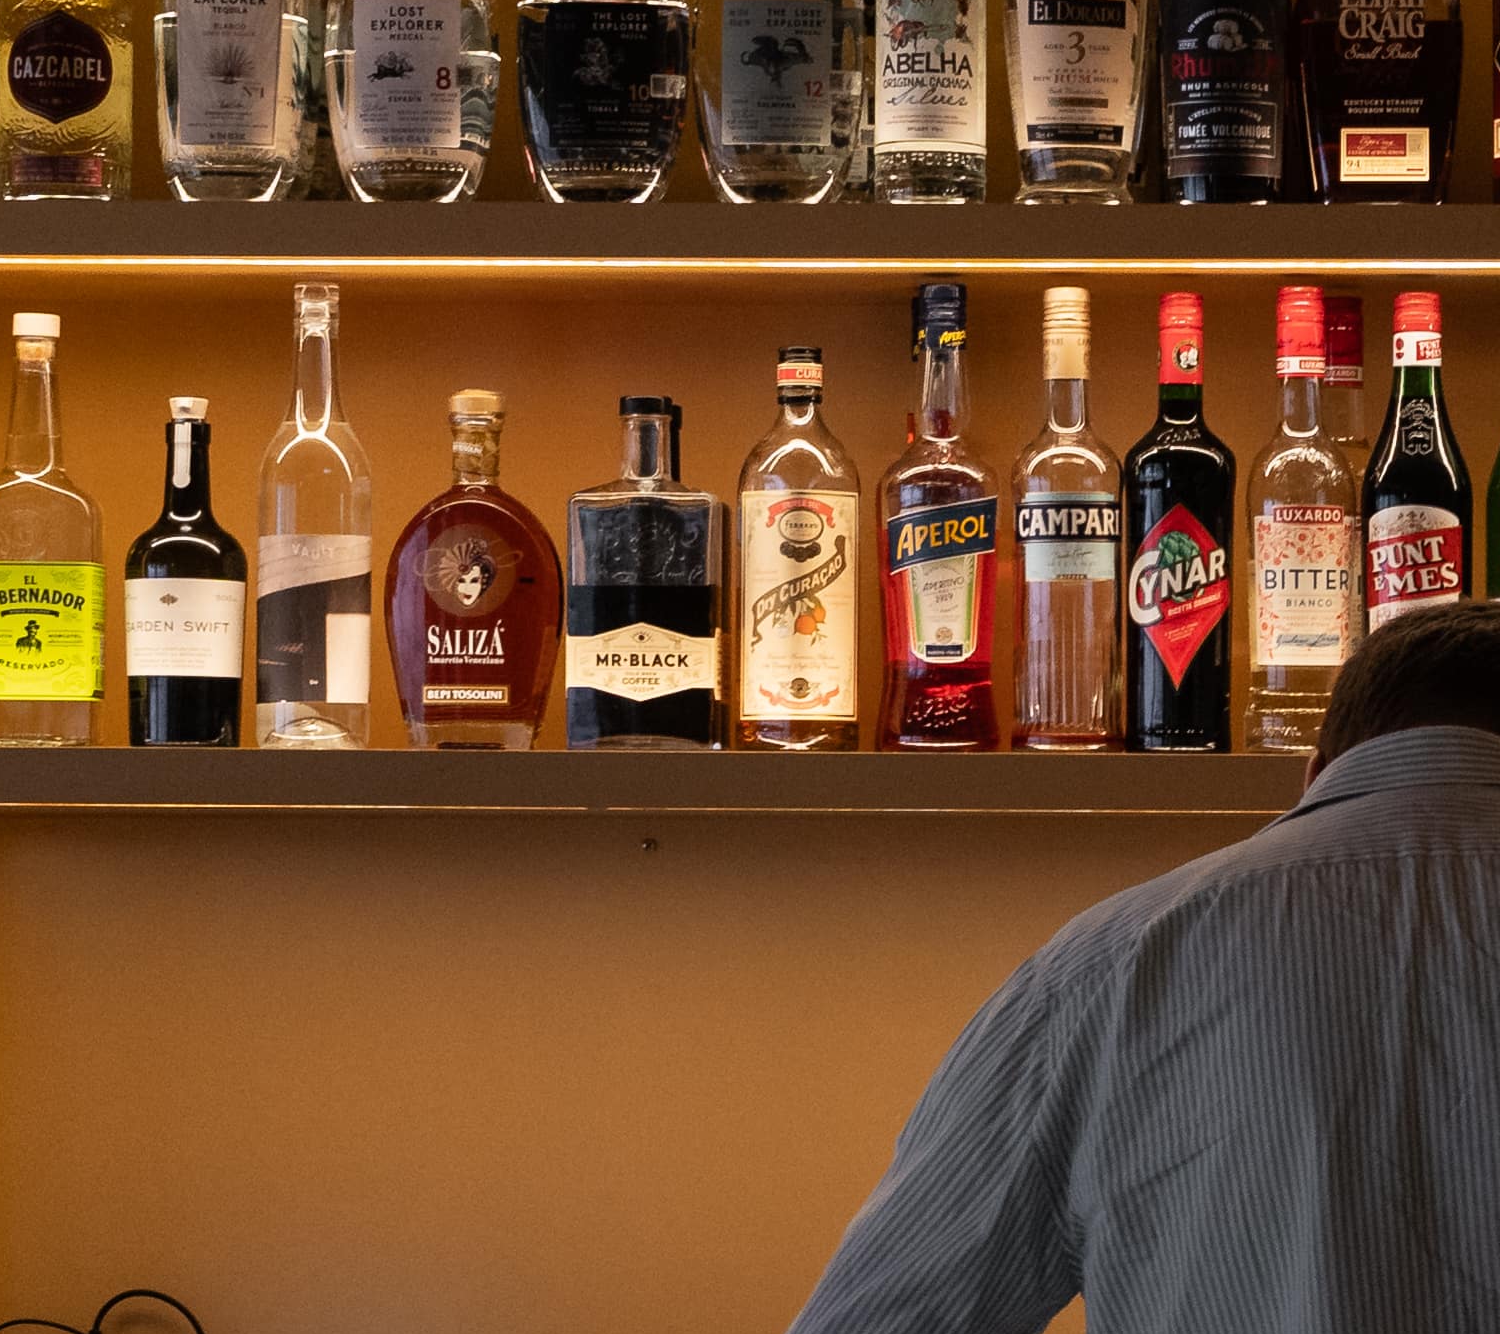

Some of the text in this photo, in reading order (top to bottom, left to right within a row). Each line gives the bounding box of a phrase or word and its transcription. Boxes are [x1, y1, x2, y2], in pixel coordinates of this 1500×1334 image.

[389, 6, 425, 17] LOST
[620, 12, 647, 21] LOST
[767, 8, 822, 17] THE LOST
[371, 20, 444, 31] EXPLORER
[766, 19, 824, 28] EXPLORER
[1338, 8, 1426, 43] CRAIG
[1066, 31, 1086, 65] 3
[1344, 43, 1383, 60] Small
[12, 55, 108, 82] CAZCABEL
[883, 52, 973, 77] ABELHA
[436, 67, 451, 90] 8
[883, 76, 928, 89] ORIGINAL
[1054, 74, 1092, 84] RUM
[628, 83, 649, 101] 10
[804, 81, 823, 97] 12
[1212, 124, 1272, 139] VOLCANIQUE
[1018, 508, 1119, 537] CAMPARI
[1275, 507, 1342, 522] LUXARDO
[896, 514, 989, 560] APEROL
[1370, 535, 1445, 574] PUNT
[23, 575, 37, 586] EL
[779, 553, 843, 604] CURAÇAO
[1264, 569, 1350, 591] BITTER
[1385, 562, 1460, 598] MES
[1128, 547, 1227, 627] CYNAR
[1286, 599, 1333, 608] BIANCO
[183, 621, 230, 633] SWIFT
[427, 619, 502, 656] SALIZÁ
[622, 677, 660, 685] COFFEE
[427, 689, 503, 700] BEPI TOSOLINI
